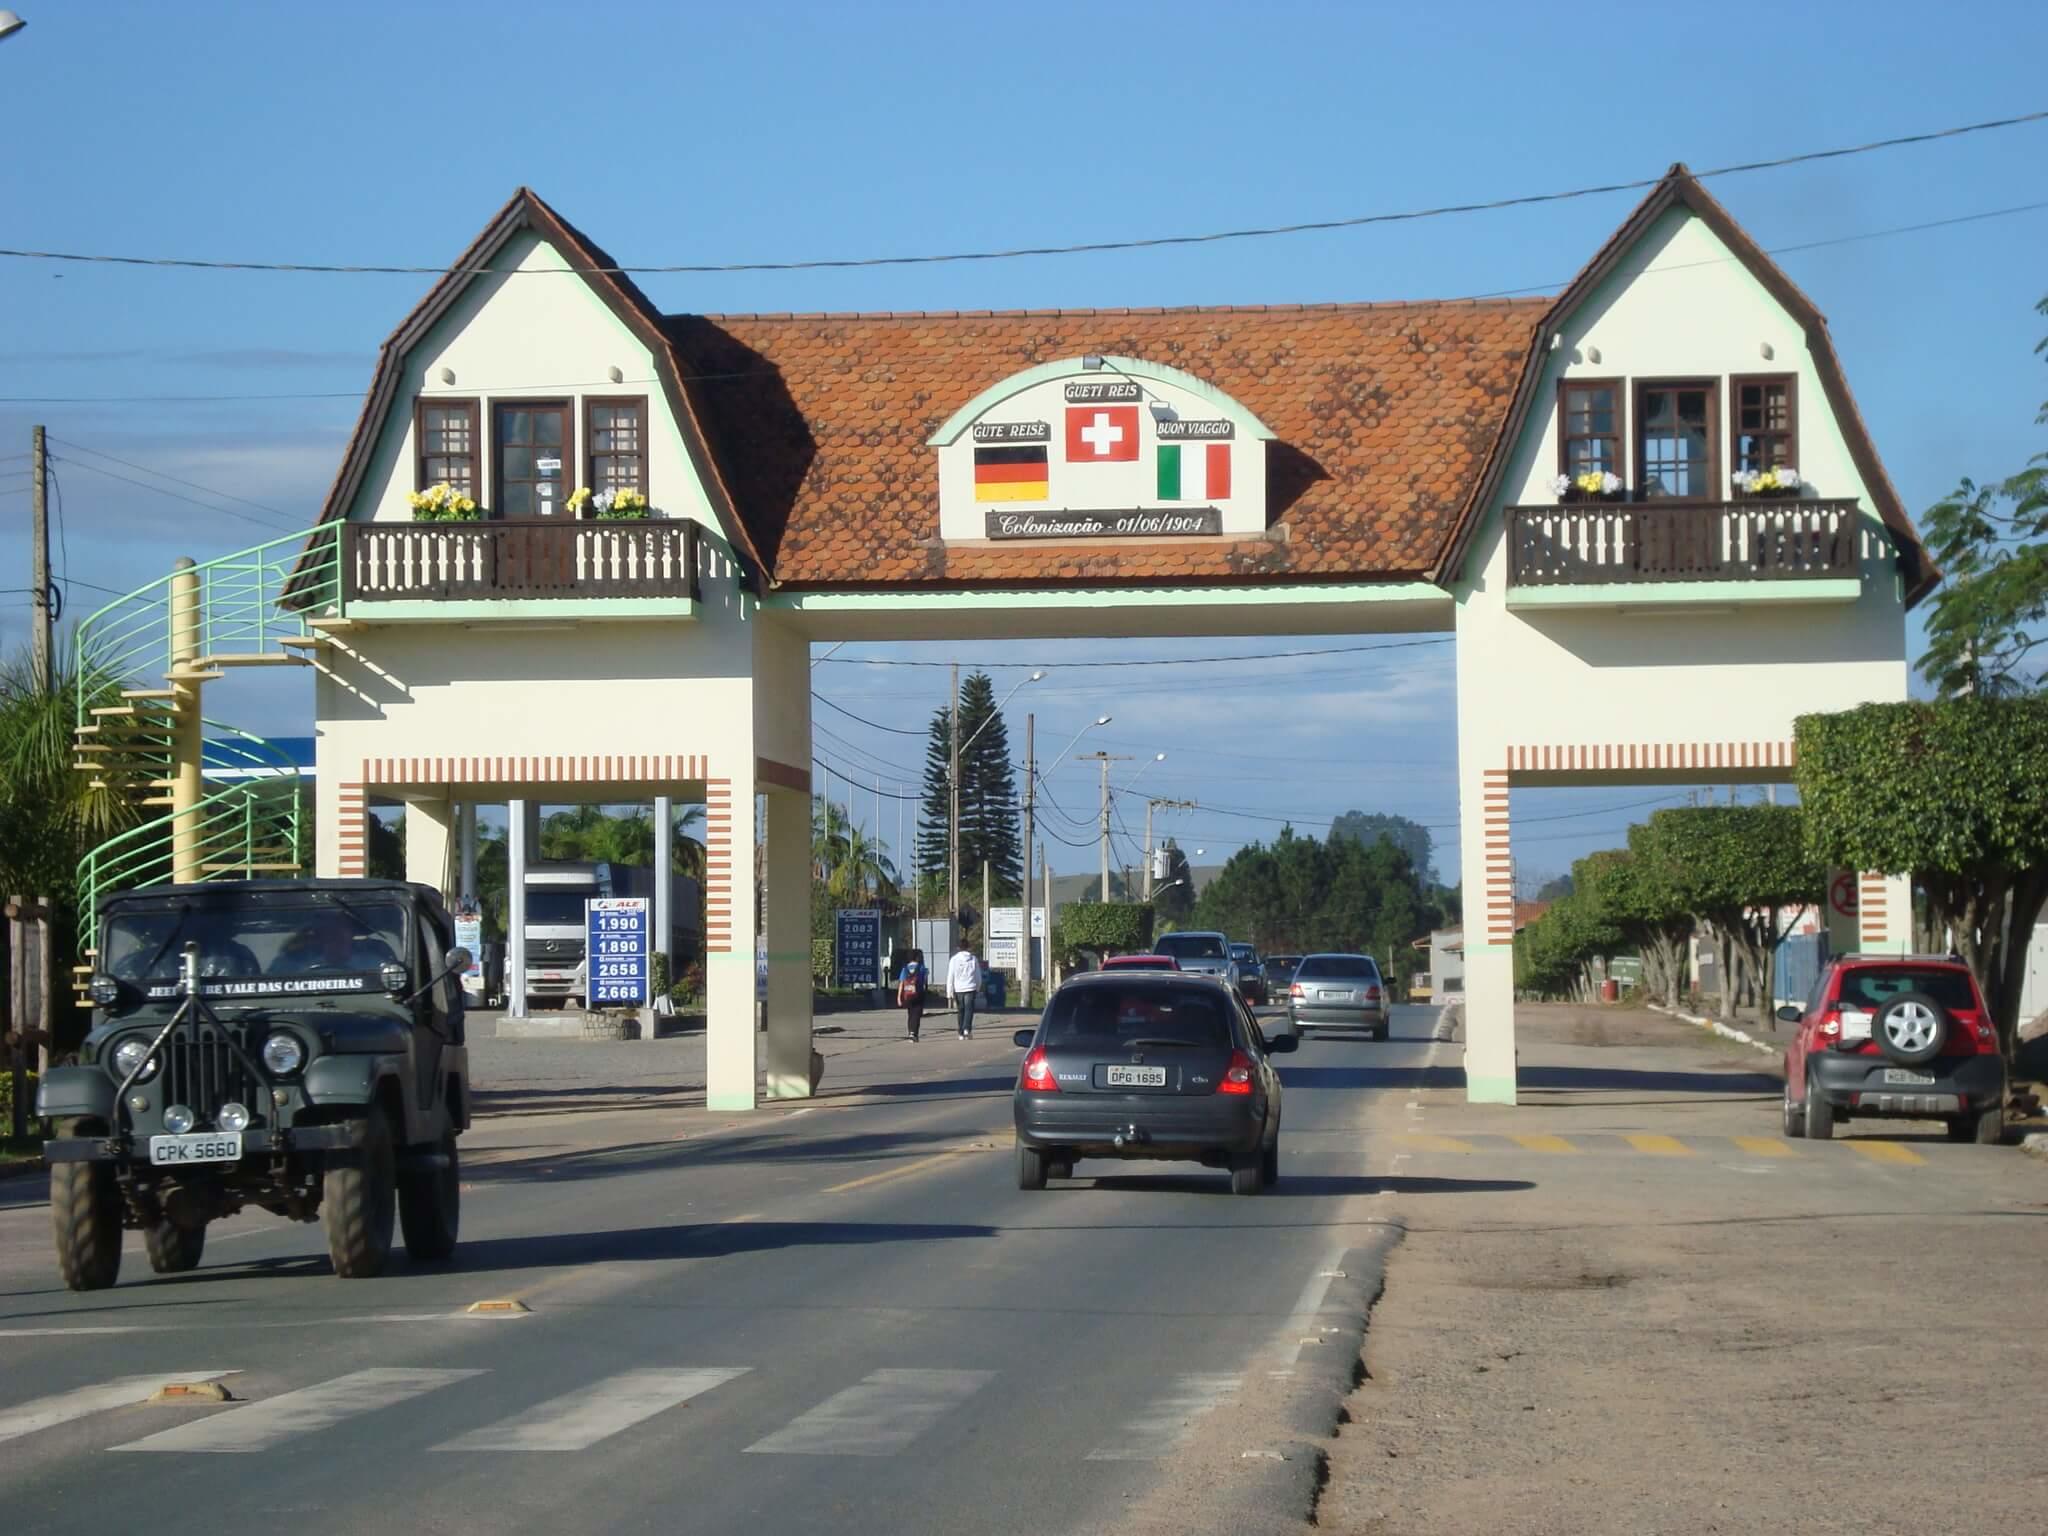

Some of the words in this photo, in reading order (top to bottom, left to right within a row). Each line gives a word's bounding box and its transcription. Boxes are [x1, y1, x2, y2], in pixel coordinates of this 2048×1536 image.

[1065, 385, 1102, 399] GUETI
[1107, 384, 1138, 398] REIS
[974, 425, 1004, 439] GUTE
[1008, 423, 1046, 437] REISE
[1157, 422, 1186, 435] BUON
[1187, 421, 1231, 435] VIAGGIO
[999, 513, 1103, 536] Colonização
[1116, 513, 1203, 533] 01/06/1904
[224, 983, 257, 994] VALE
[257, 982, 283, 993] DAS
[284, 978, 364, 992] CACHOEIRAS
[156, 1145, 188, 1161] CPK
[194, 1141, 236, 1159] 5660
